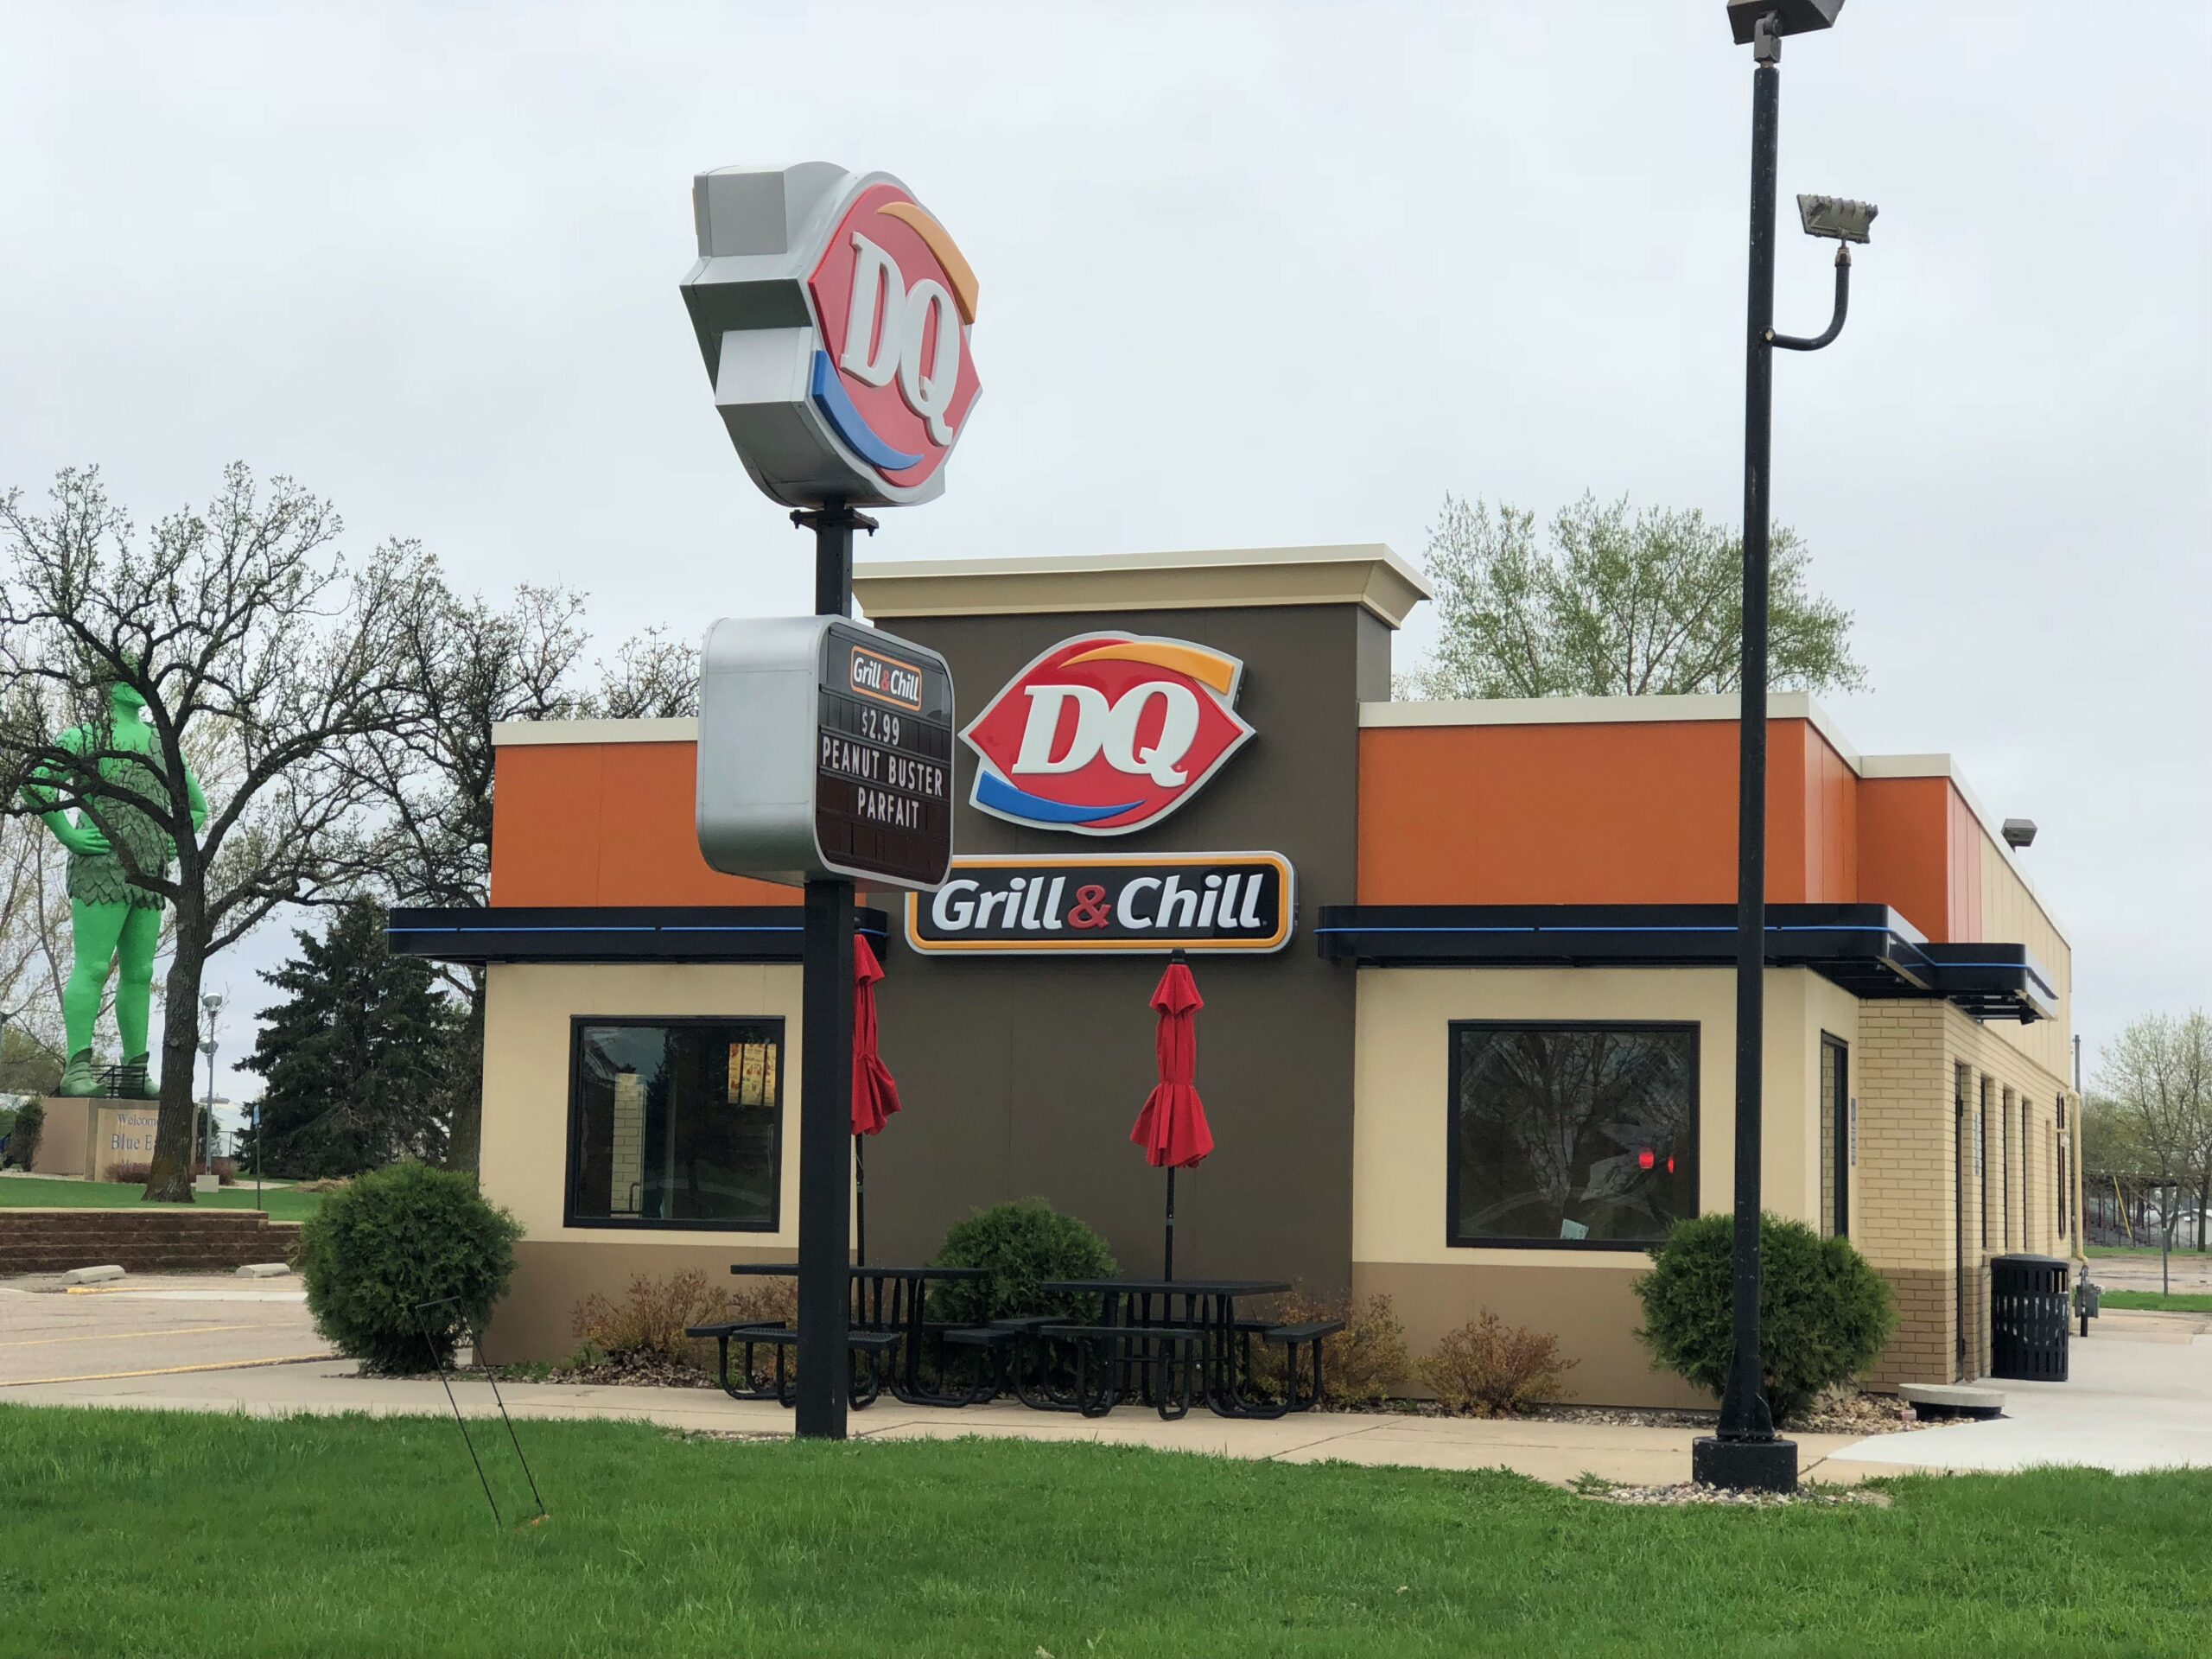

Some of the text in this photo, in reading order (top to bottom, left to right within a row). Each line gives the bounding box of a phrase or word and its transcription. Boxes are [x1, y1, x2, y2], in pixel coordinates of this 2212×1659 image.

[840, 231, 960, 447] DQ
[861, 707, 900, 746] $2.99
[1011, 681, 1200, 787] DQ
[823, 736, 943, 797] PEANUT BUSTER
[858, 787, 918, 829] PARFAIT
[118, 1114, 159, 1126] Welcom
[111, 1134, 140, 1150] Blue
